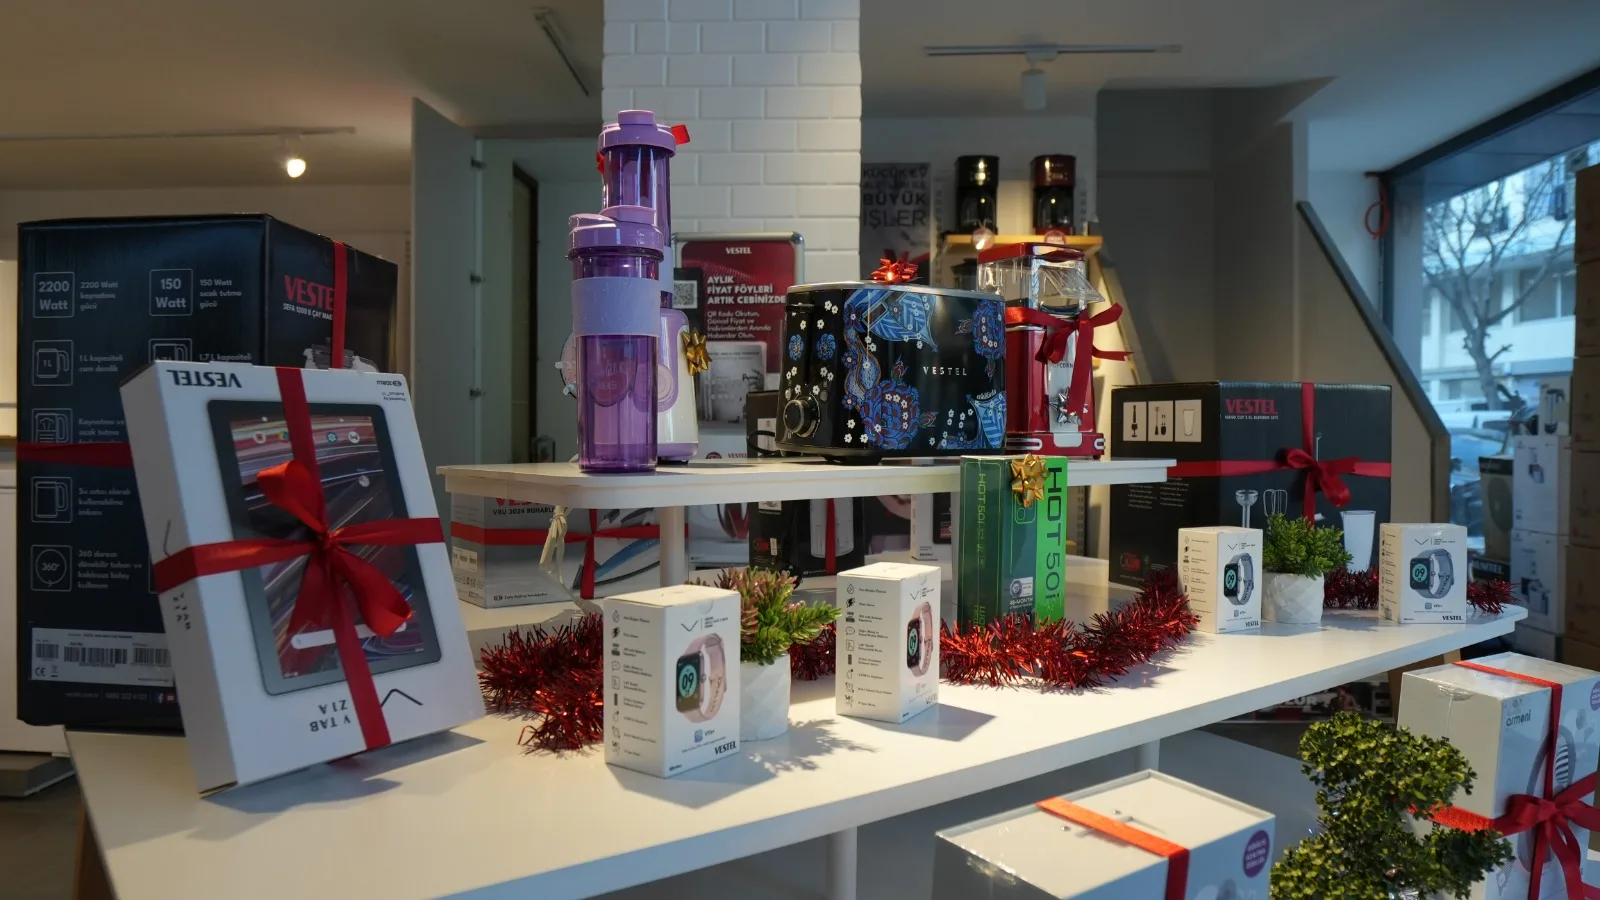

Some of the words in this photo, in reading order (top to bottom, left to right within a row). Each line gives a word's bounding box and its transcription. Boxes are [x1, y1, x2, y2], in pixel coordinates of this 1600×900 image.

[726, 247, 752, 255] VESTEL
[80, 281, 99, 289] 2200
[161, 278, 182, 290] 150
[707, 276, 734, 284] AYLIK
[38, 281, 70, 292] 2200
[707, 284, 732, 294] FİYAT
[735, 283, 773, 294] FÖYLERİ
[284, 274, 334, 312] VESTE
[707, 296, 734, 304] ARTIK
[737, 294, 786, 304] CEBİNİZDE
[39, 299, 69, 311] Watt
[155, 296, 187, 308] Watt
[322, 312, 333, 320] MAK
[923, 366, 967, 376] VESTEL
[166, 369, 243, 388] VESTEL
[1225, 399, 1279, 415] VESTEL
[1047, 467, 1062, 546] HOT
[1045, 552, 1061, 599] 50i
[681, 672, 694, 691] 09
[309, 717, 338, 732] TAB
[1505, 709, 1531, 728] armoni
[714, 740, 737, 755] VESTEL
